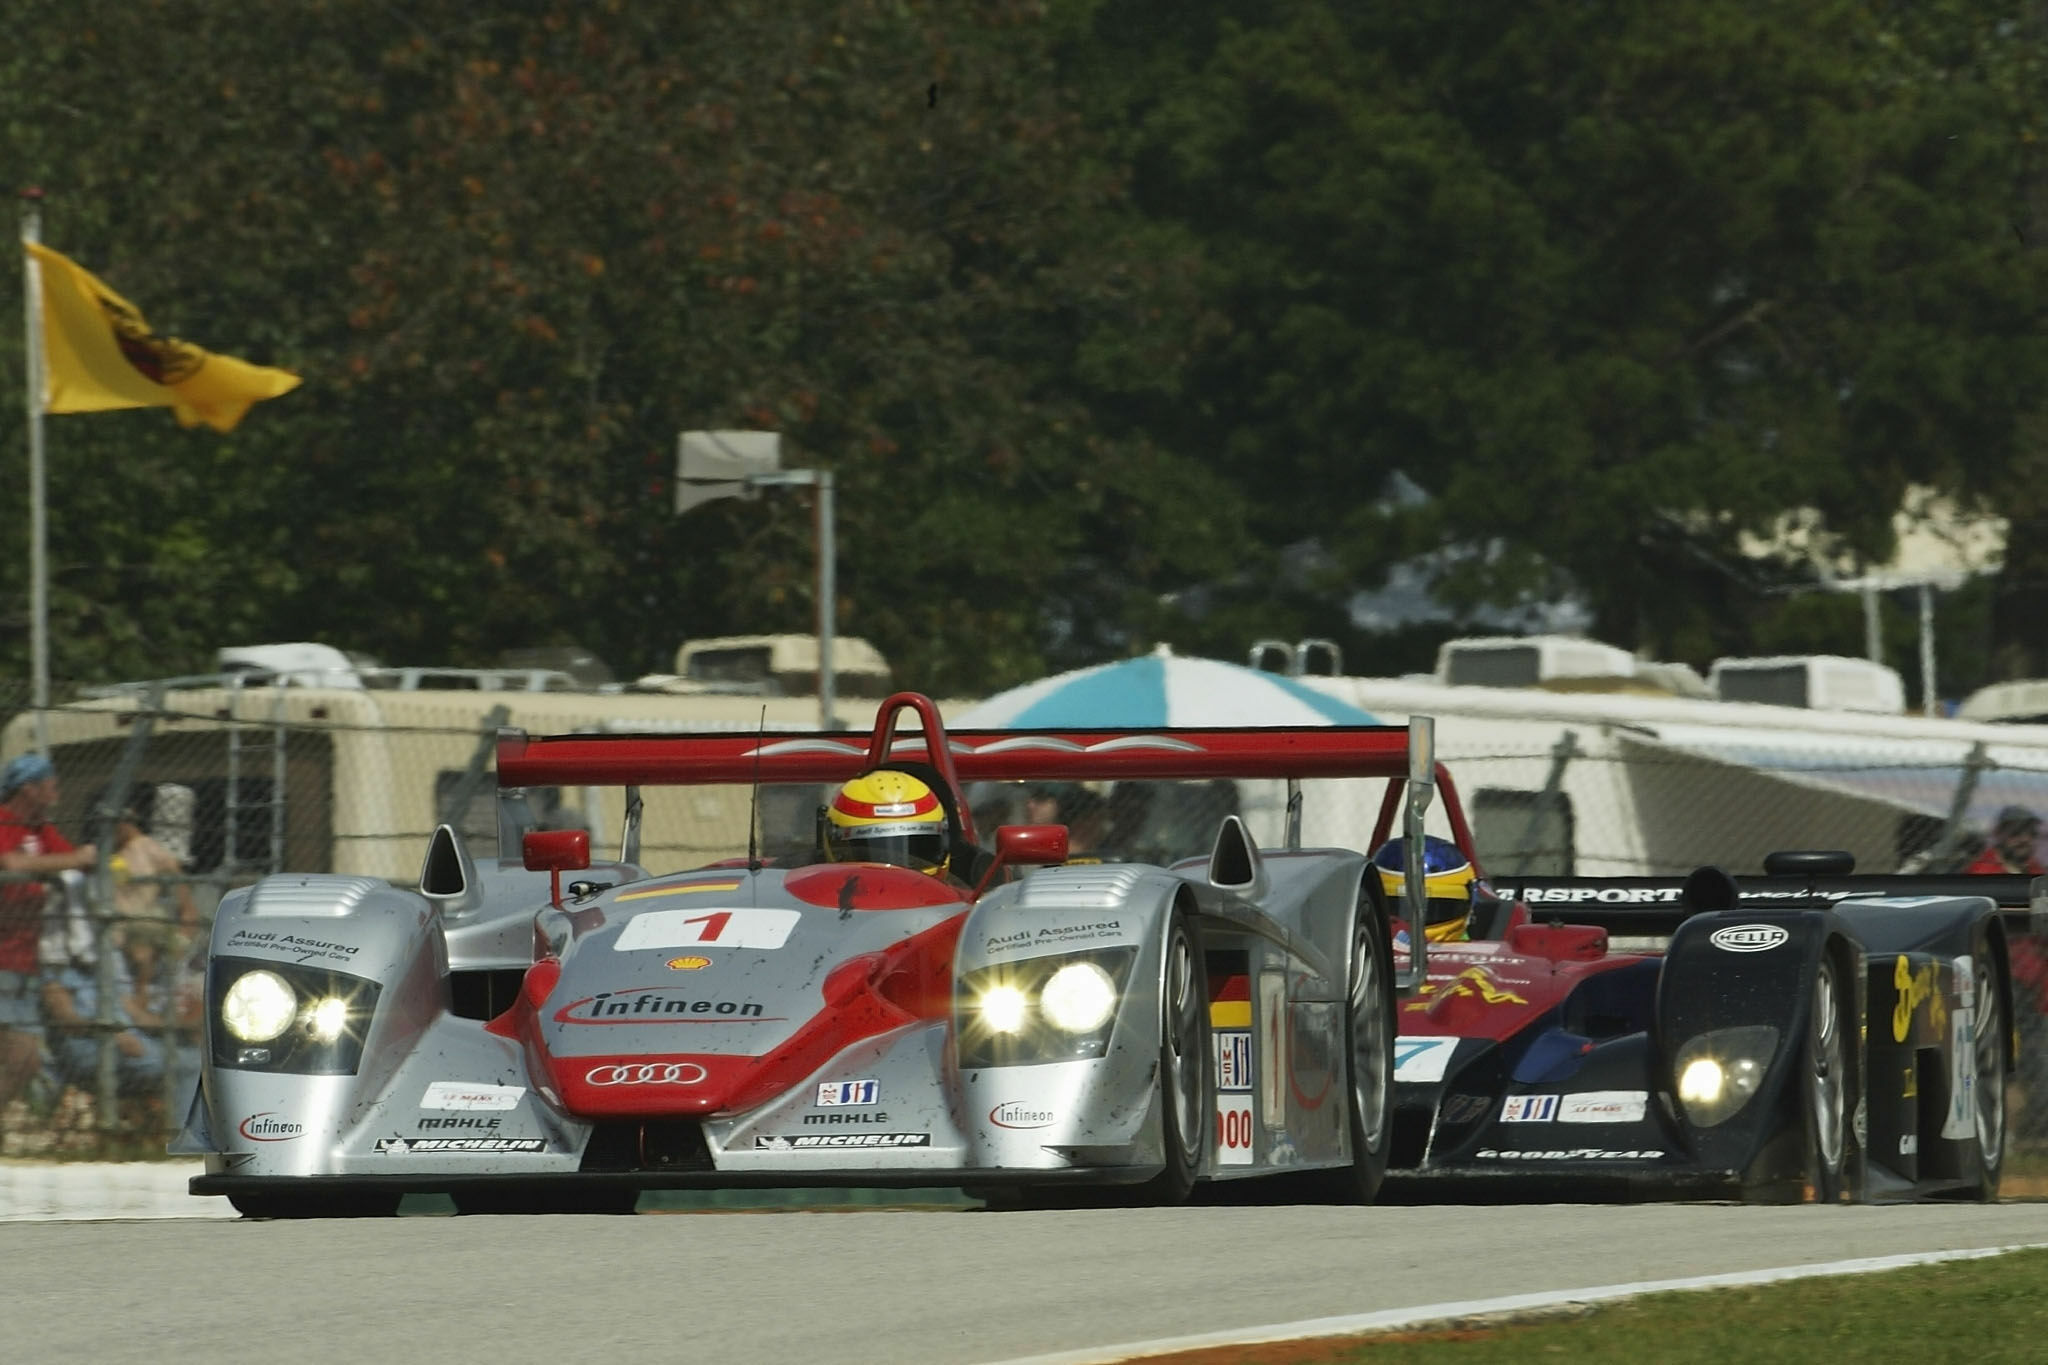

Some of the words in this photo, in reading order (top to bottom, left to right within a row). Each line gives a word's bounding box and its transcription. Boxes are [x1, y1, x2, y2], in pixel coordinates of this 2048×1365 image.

[683, 911, 733, 942] 1
[986, 930, 1031, 947] Audi
[1038, 921, 1120, 937] Assured
[1097, 930, 1122, 938] Cars
[1720, 931, 1784, 942] HELLA
[232, 930, 278, 941] Audi
[280, 935, 360, 955] Assured
[328, 952, 351, 963] Cars
[417, 1118, 502, 1129] MAHLE
[803, 1112, 887, 1125] MAHLE
[412, 1139, 542, 1150] MICHELIN
[794, 1134, 925, 1147] MICHELIN
